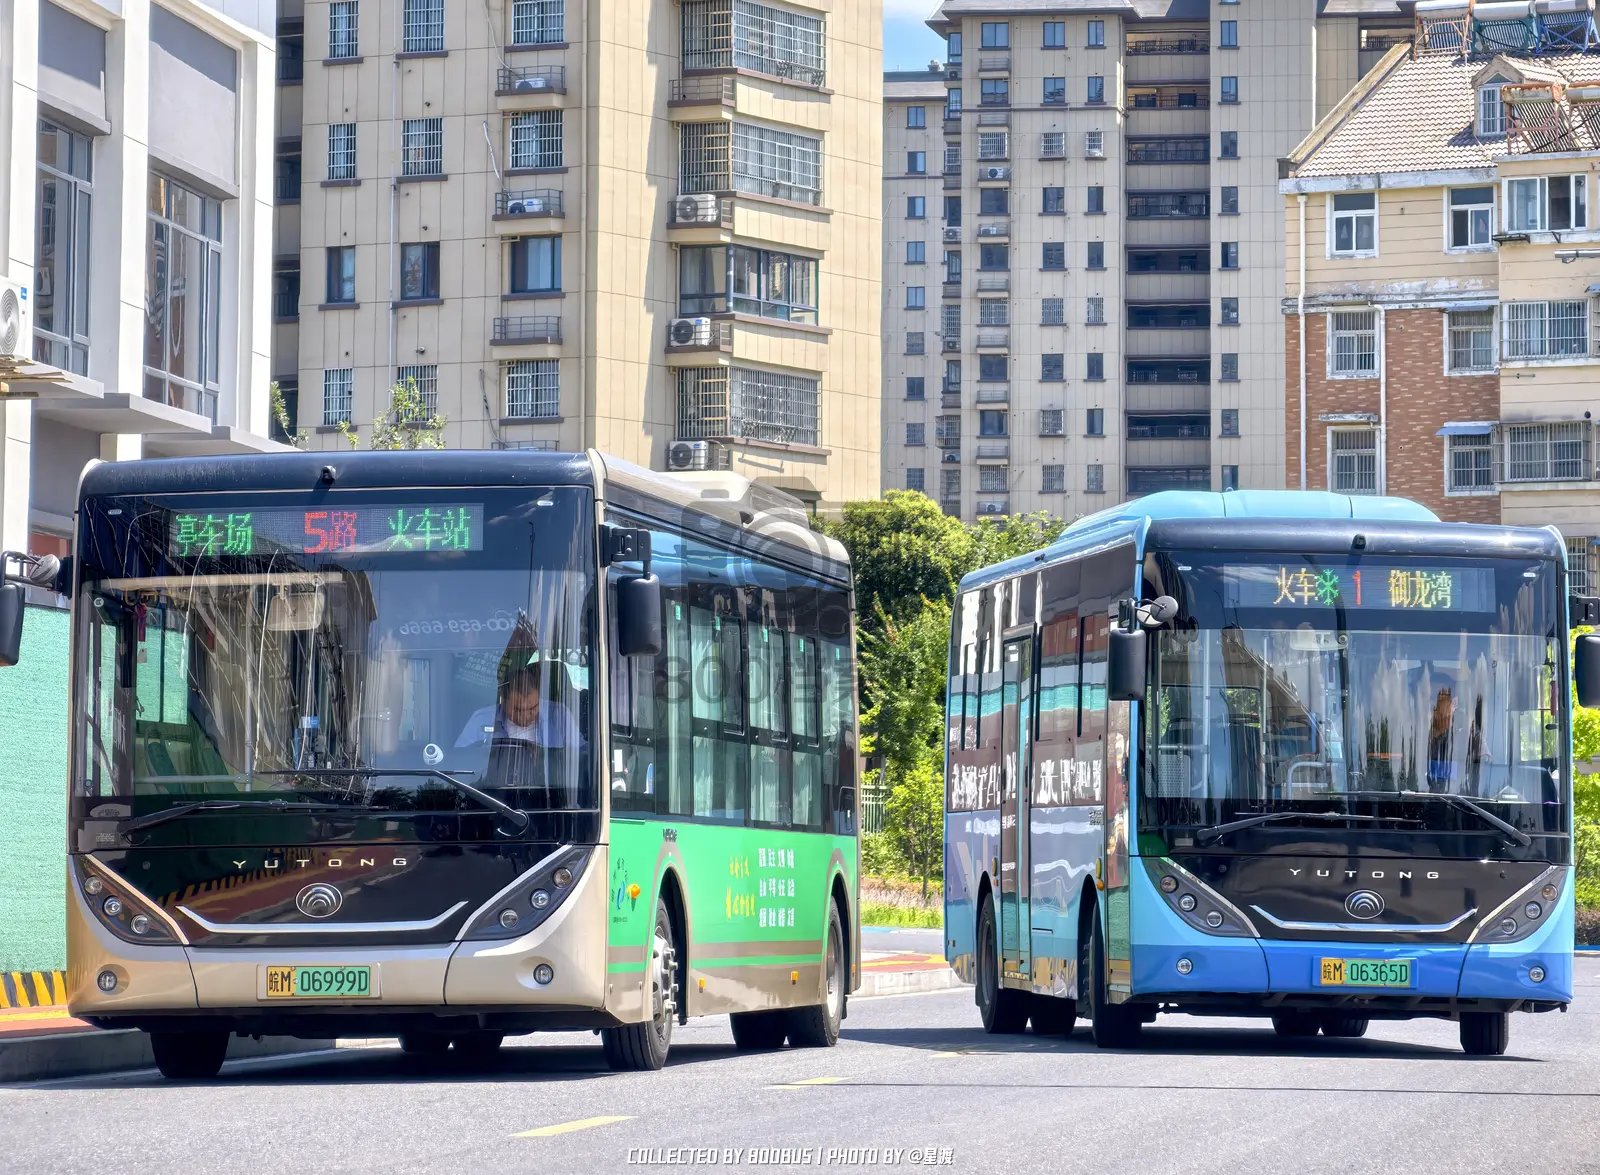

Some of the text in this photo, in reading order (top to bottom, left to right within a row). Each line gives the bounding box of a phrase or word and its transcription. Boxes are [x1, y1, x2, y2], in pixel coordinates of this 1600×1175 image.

[303, 510, 357, 553] 5路
[387, 507, 471, 551] 火车站
[1272, 567, 1322, 606] 火车
[1388, 569, 1452, 608] 御龙湾
[232, 857, 408, 869] YUTONG
[1289, 868, 1440, 880] YUTONG
